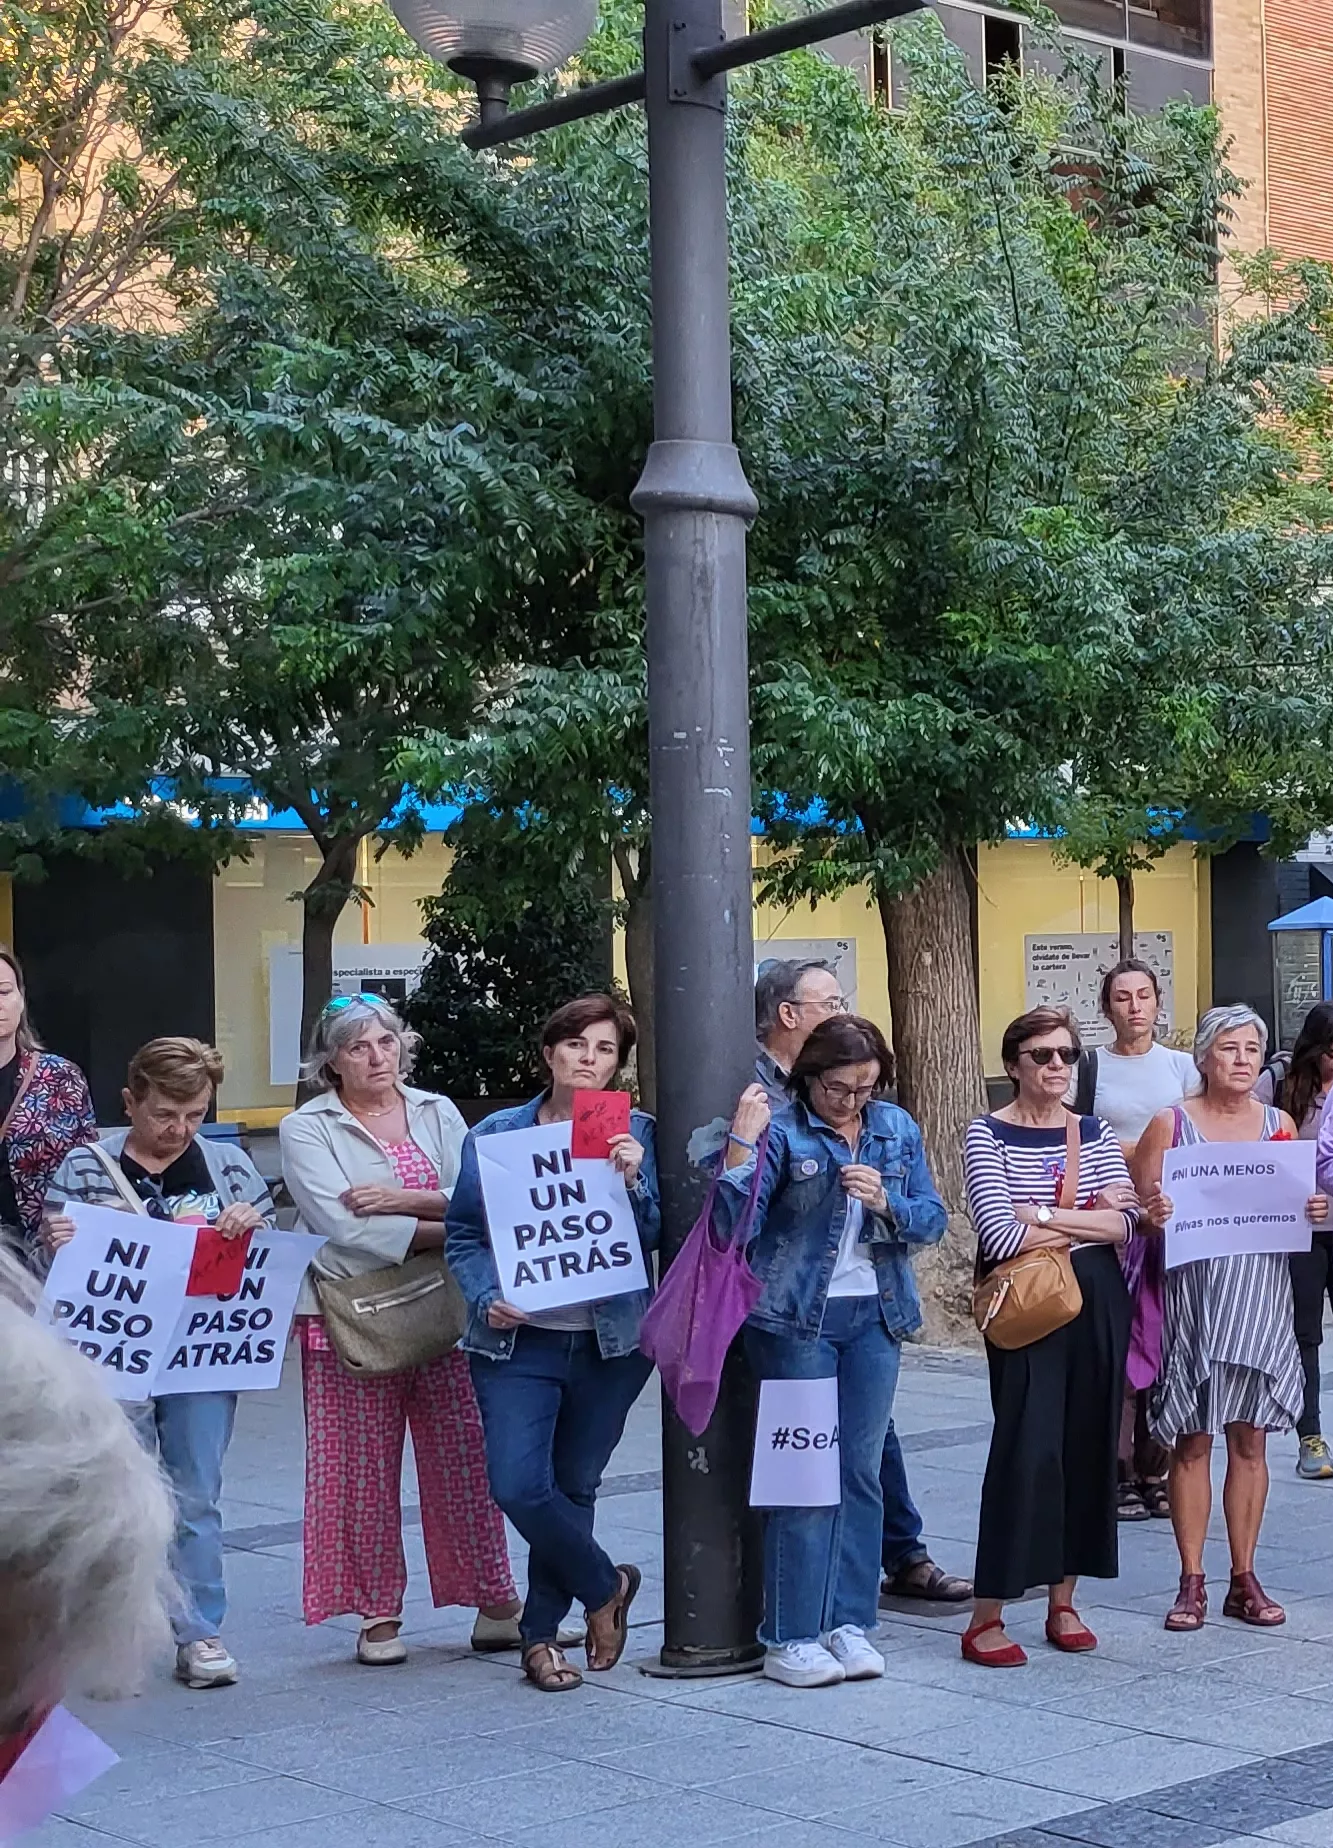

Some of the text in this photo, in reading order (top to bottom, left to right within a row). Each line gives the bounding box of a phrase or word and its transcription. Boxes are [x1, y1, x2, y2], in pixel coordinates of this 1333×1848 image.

[1032, 943, 1048, 951] Este
[333, 968, 383, 979] specialista
[532, 1148, 573, 1178] NI
[1172, 1163, 1275, 1181] #NI UNA MENOS
[529, 1179, 587, 1211] UN
[513, 1209, 613, 1251] PASO
[1175, 1212, 1297, 1234] #Vivas nos queremos
[104, 1237, 151, 1270] NI
[513, 1239, 633, 1288] ATRÁS
[86, 1269, 148, 1304] UN
[53, 1299, 153, 1338] PASO
[186, 1307, 273, 1336] PASO
[167, 1334, 276, 1370] ATRÁS
[771, 1425, 839, 1450] #SeA
